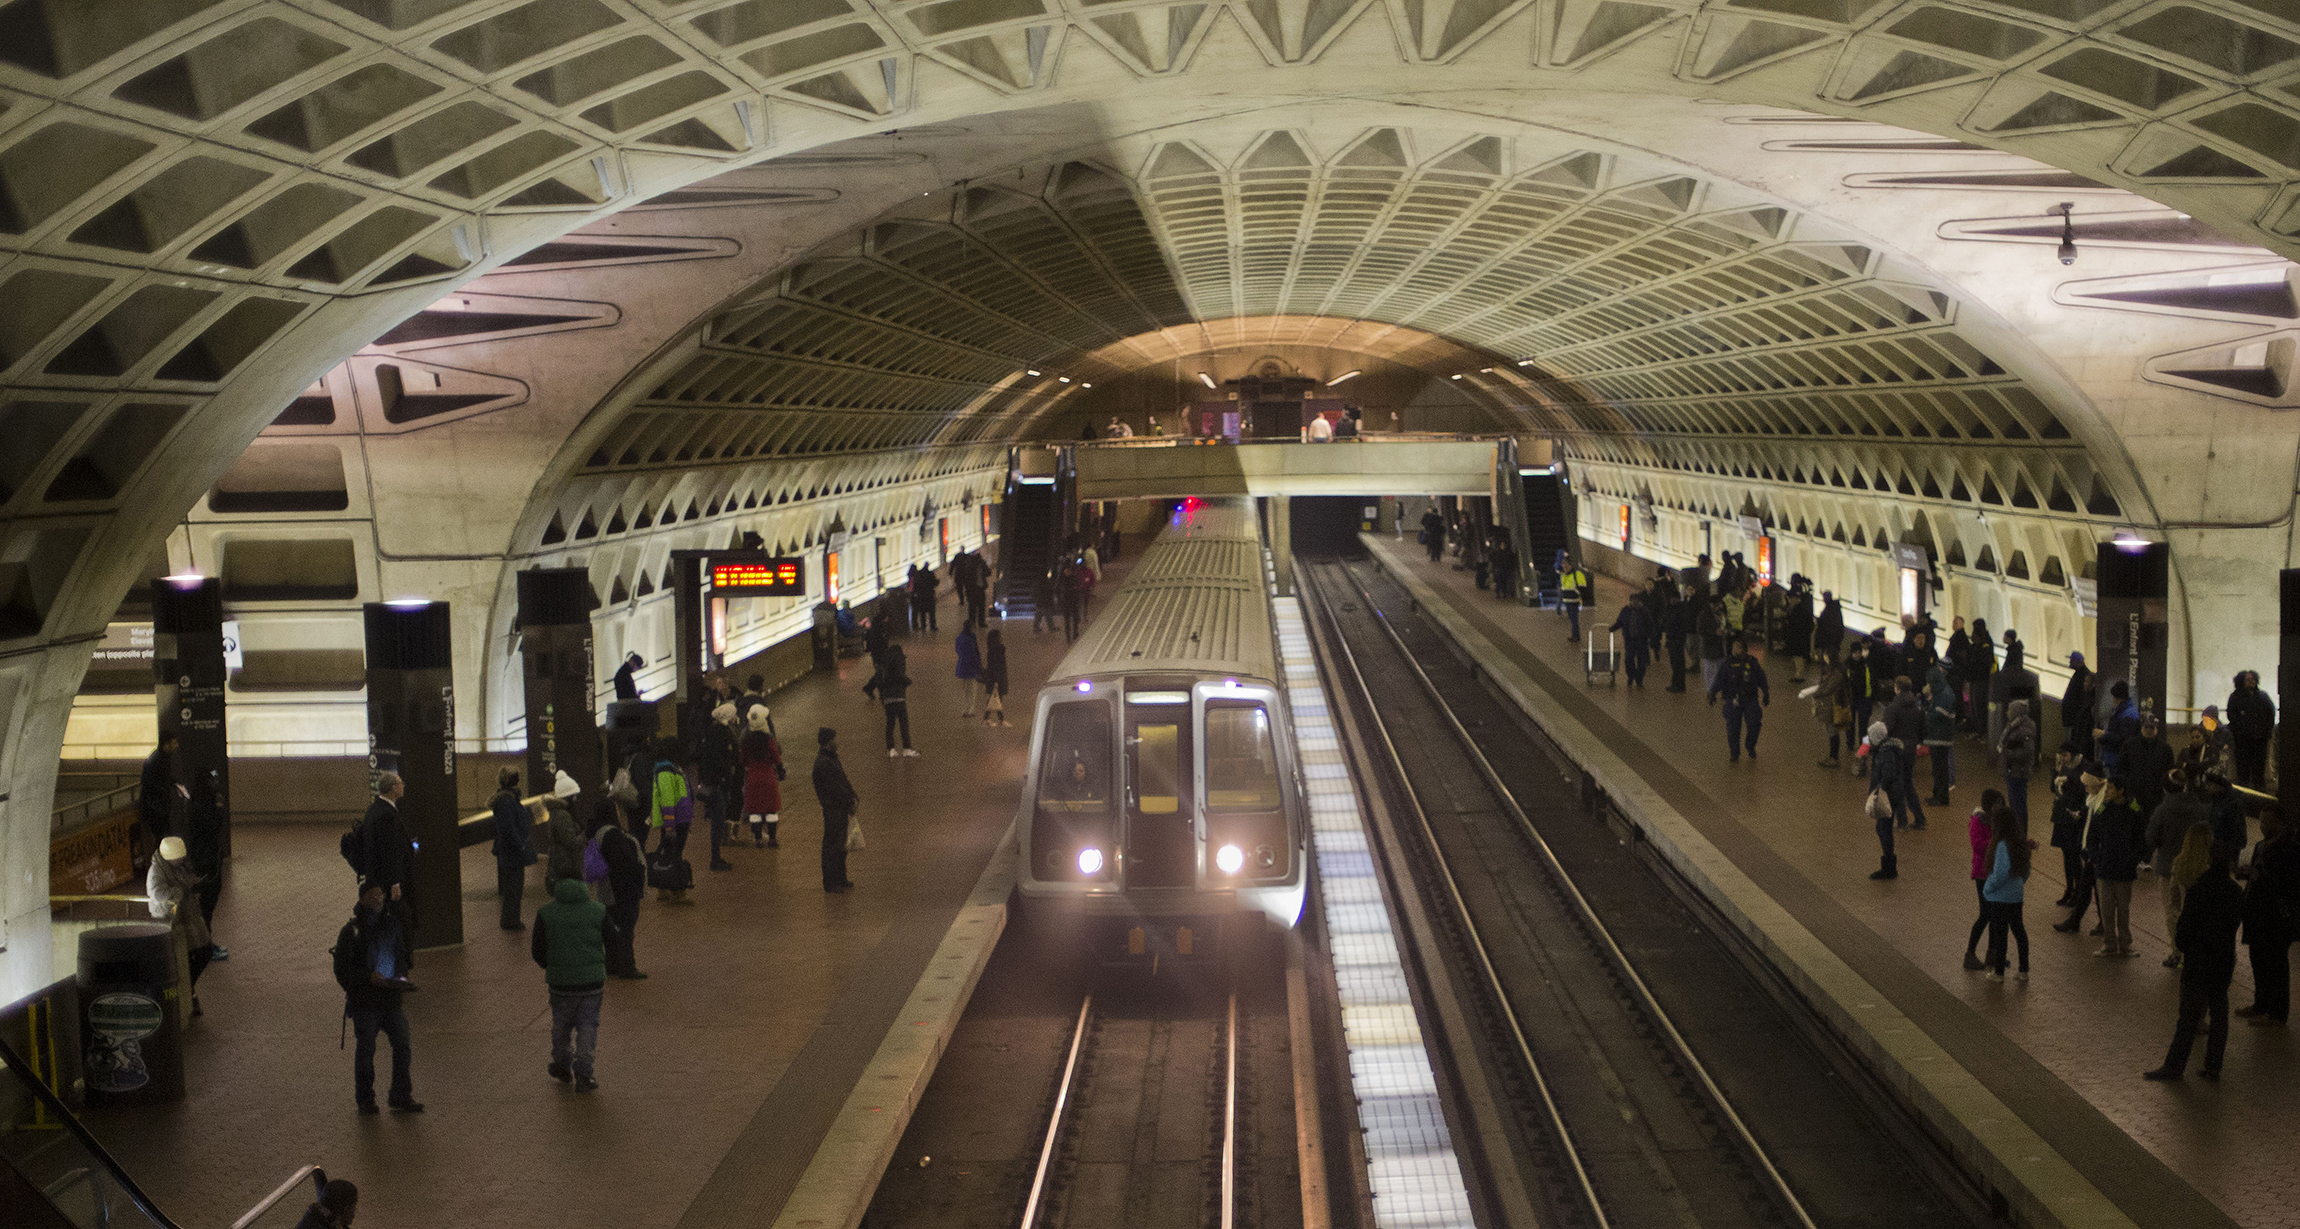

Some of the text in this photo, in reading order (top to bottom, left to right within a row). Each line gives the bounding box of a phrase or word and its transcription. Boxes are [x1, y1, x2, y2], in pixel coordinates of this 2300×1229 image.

[2129, 613, 2139, 687] L'Enfant Plaza
[443, 740, 455, 775] Plaza
